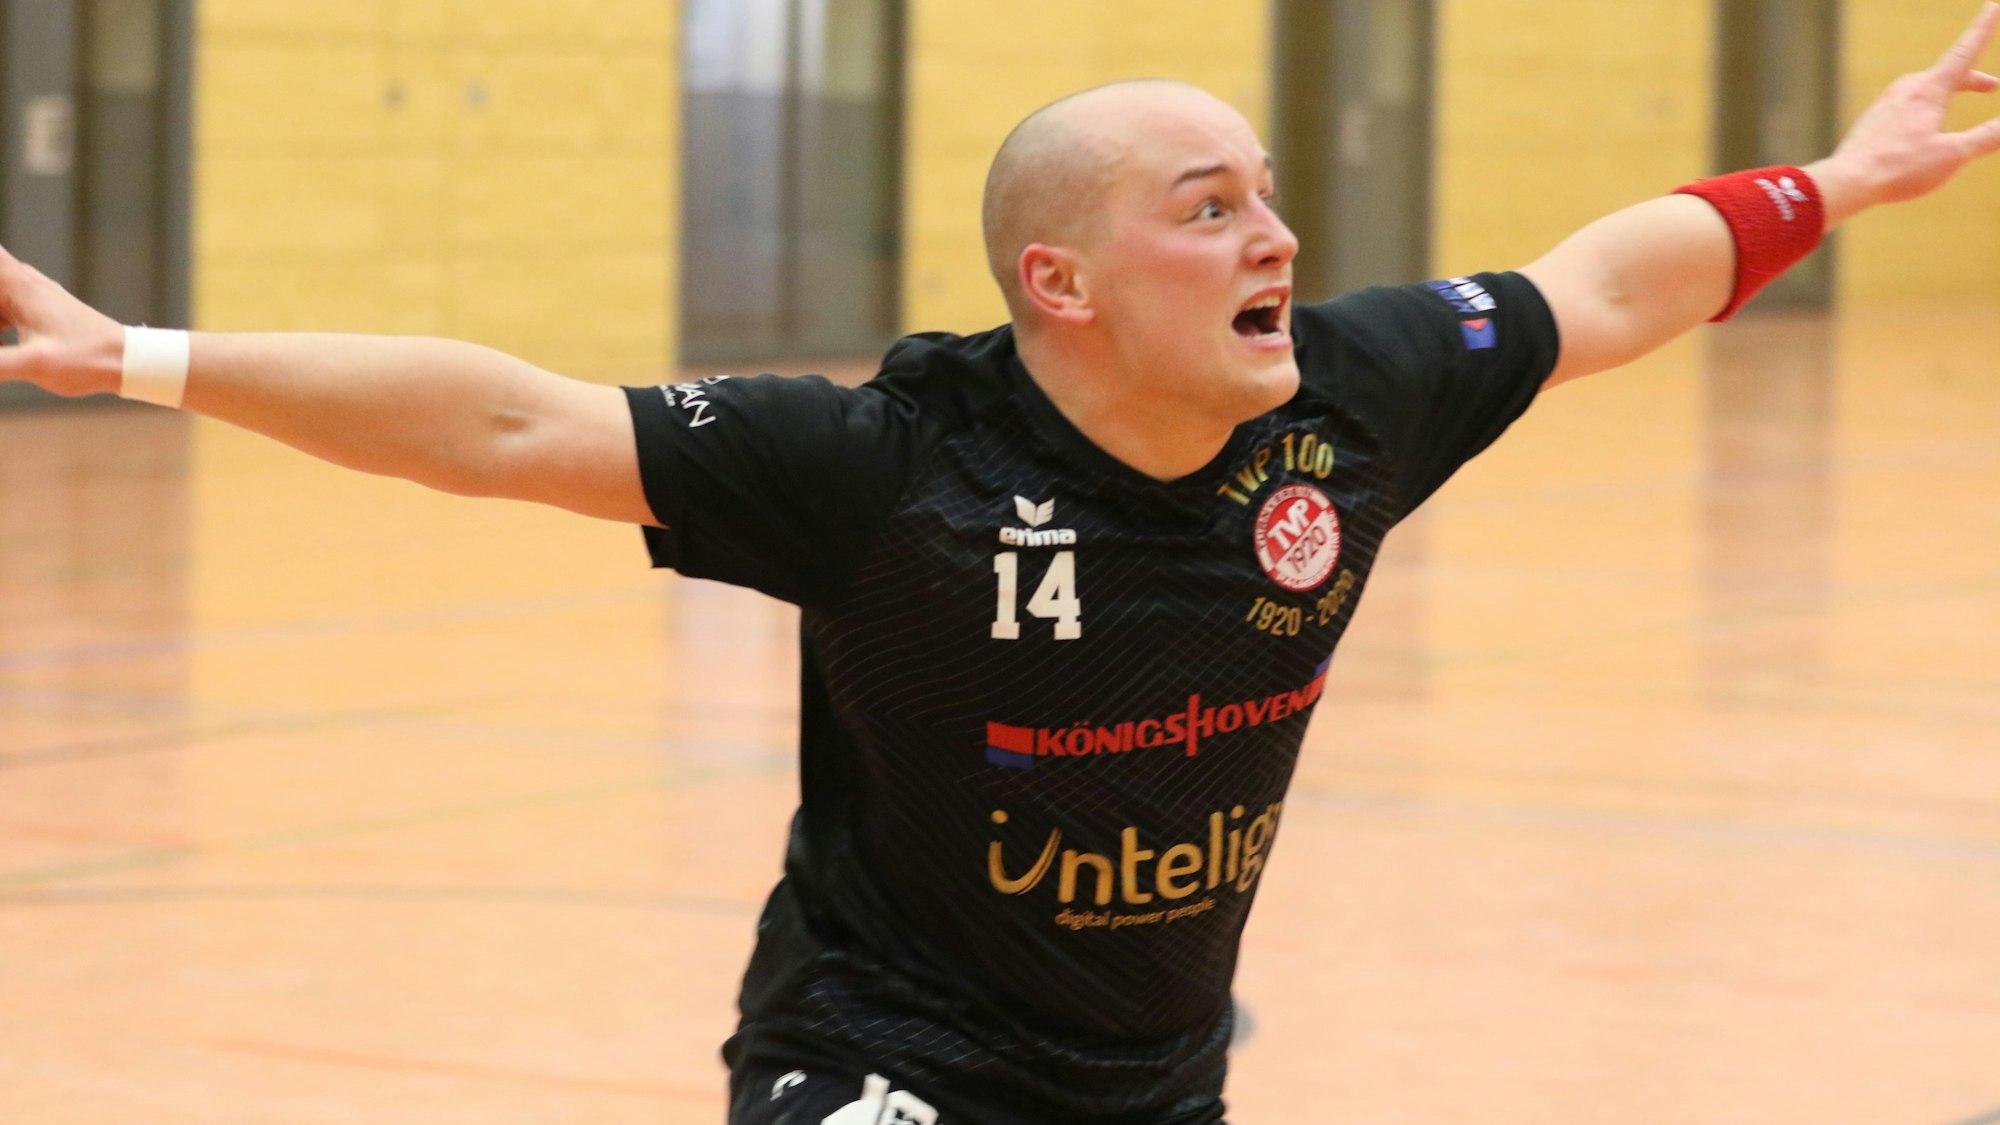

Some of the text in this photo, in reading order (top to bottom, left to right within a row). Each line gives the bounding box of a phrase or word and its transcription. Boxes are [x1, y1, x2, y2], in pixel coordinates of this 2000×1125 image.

[1216, 432, 1335, 506] TVP 100
[999, 526, 1077, 547] erima
[1265, 498, 1311, 552] TVP
[1286, 526, 1328, 575] 1920
[991, 550, 1082, 641] 14
[1246, 596, 1301, 637] 1920
[1055, 895, 1217, 931] digital power people
